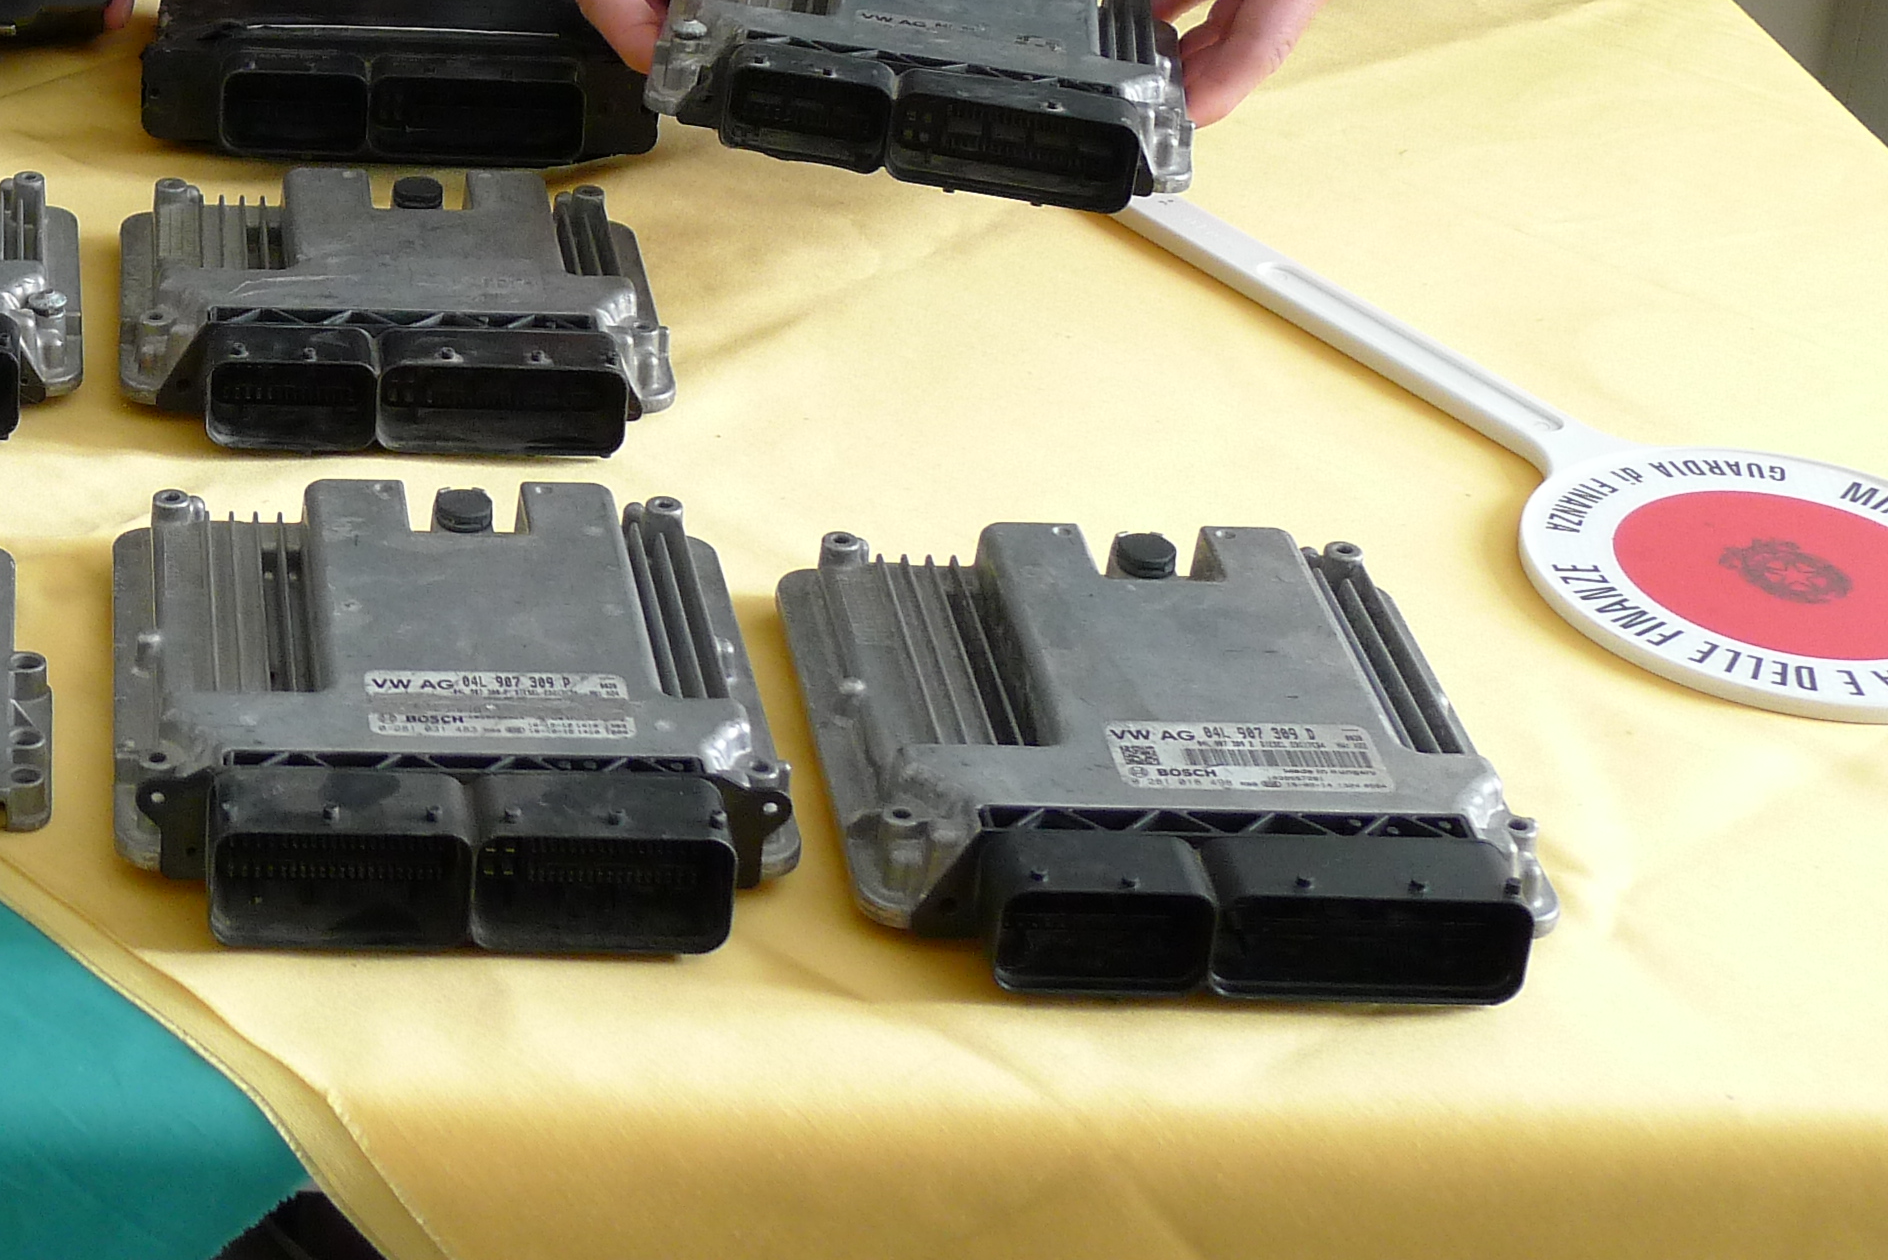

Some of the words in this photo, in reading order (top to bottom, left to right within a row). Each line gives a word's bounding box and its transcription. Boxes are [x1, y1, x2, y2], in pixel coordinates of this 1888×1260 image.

[1610, 467, 1644, 487] di
[1648, 460, 1786, 482] GUARDIA
[1546, 477, 1619, 534] FINANZA
[1552, 563, 1686, 646] FINANZE
[1688, 640, 1818, 692] DELLE
[372, 678, 411, 690] VW
[420, 679, 454, 690] AG
[462, 675, 487, 688] 04L
[495, 676, 520, 688] 907
[530, 677, 554, 688] 309
[562, 677, 571, 688] P
[1836, 669, 1866, 696] E
[406, 715, 464, 724] BOSCH
[1110, 728, 1150, 740] VW
[1161, 730, 1195, 741] AG
[1203, 727, 1231, 739] 04L
[1237, 727, 1262, 739] 907
[1272, 728, 1298, 740] 309
[1157, 768, 1217, 778] BOSCH
